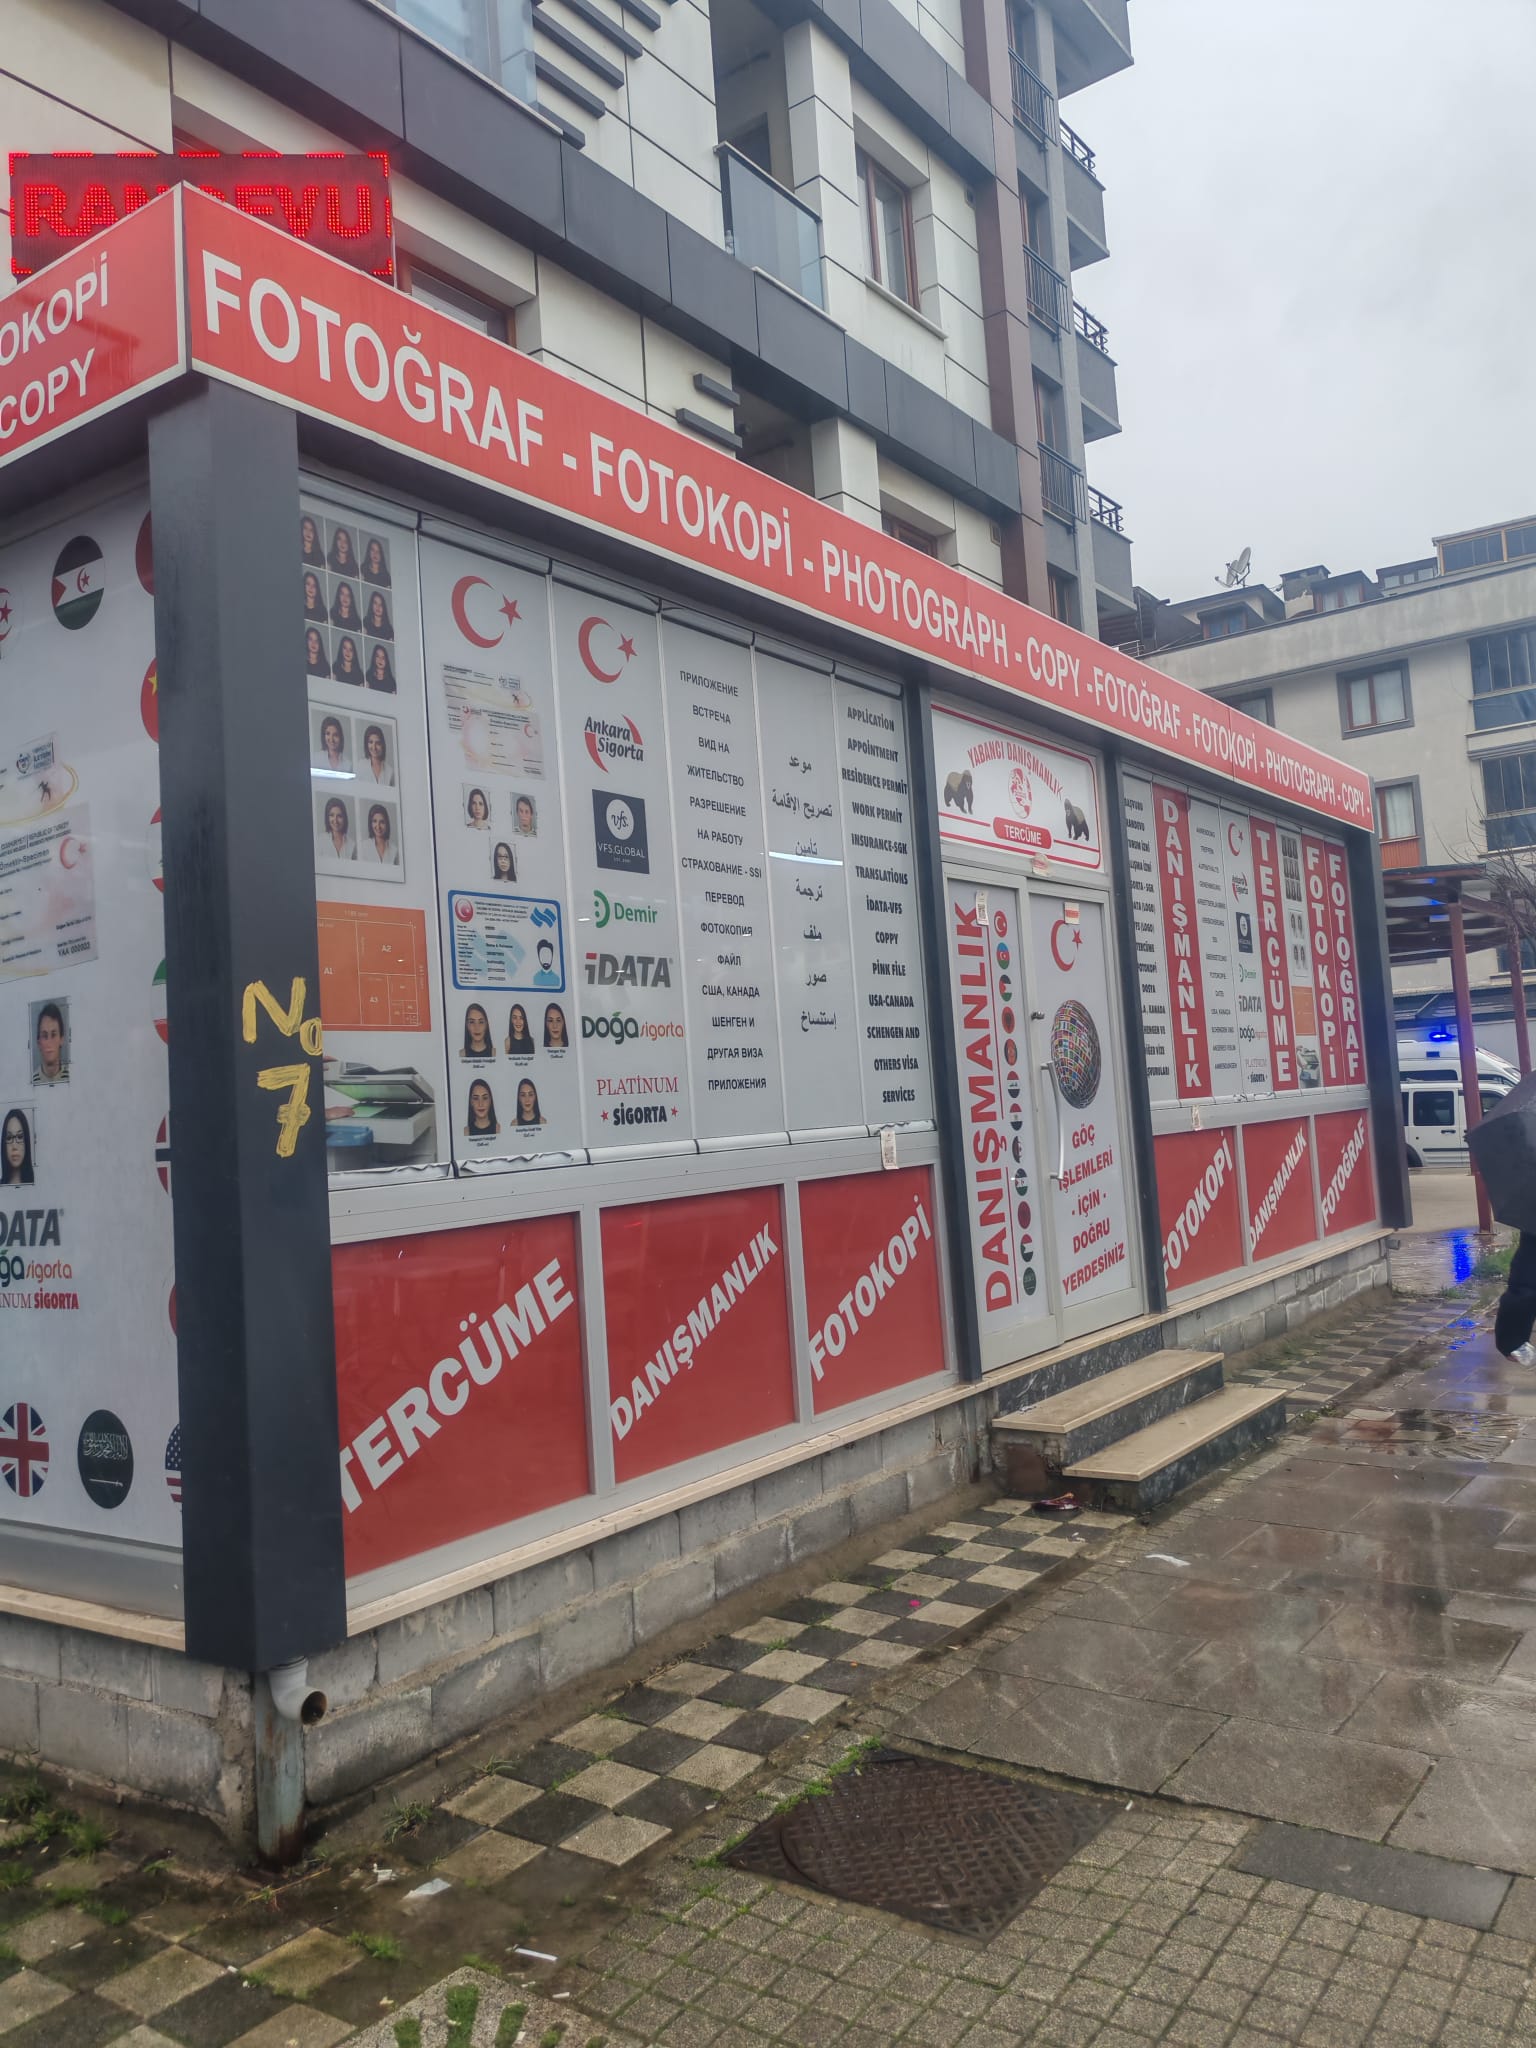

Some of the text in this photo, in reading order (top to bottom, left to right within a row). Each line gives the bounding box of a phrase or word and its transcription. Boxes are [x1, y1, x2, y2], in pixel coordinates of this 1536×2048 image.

[0, 251, 107, 366] OKOPİ
[0, 348, 95, 438] COPY
[202, 250, 544, 467] FOTOĞRAF
[590, 432, 793, 576] FOTOKOPİ
[821, 540, 1008, 668] PHOTOGRAPH
[1026, 637, 1080, 697] COPY
[1193, 713, 1258, 773] FOTOKOPİ
[1266, 748, 1336, 806] PHOTOGRAPH
[1341, 783, 1364, 816] COPY
[679, 670, 739, 697] ПРИЛОЖЕНИЕ
[692, 704, 731, 724] ВСТРЕЧА
[584, 716, 631, 742] Ankara
[597, 737, 644, 762] Sigorta
[698, 737, 730, 754] ВИД НА
[687, 764, 744, 787] ЖИТЕЛЬСТВО
[968, 740, 1064, 801] YABANCI DANIŞMANLIK
[689, 796, 747, 817] РАЗРЕШЕНИЕ
[852, 801, 876, 818] WORK
[697, 828, 744, 846] НА РАБОТУ
[1004, 824, 1042, 846] TERCÜME
[681, 857, 743, 876] СТРАХОВАНИЕ
[705, 891, 745, 907] ПЕРЕВОД
[614, 902, 658, 923] Demir
[700, 922, 753, 937] ФОТОКОПИЯ
[875, 931, 899, 944] COPPY
[1162, 799, 1202, 1088] DANIŞMANLIK
[717, 953, 742, 966] ФАЙЛ
[1256, 829, 1291, 1082] TERCÜME
[1306, 847, 1336, 1078] FOTOKOPİ
[1328, 853, 1359, 1078] FOTOĞRAF
[726, 986, 760, 999] КАНАДА
[868, 993, 914, 1008] USA-CANADA
[712, 1016, 755, 1028] ШЕНГЕН И
[867, 1026, 920, 1039] SCHENGEN AND
[707, 1047, 763, 1060] ДРУГАЯ ВИЗА
[874, 1058, 901, 1071] OTHERS
[597, 1075, 679, 1096] PLATİNUM
[708, 1078, 766, 1091] ПРИЛОЖЕНИЯ
[256, 1062, 311, 1158] 7
[613, 1103, 667, 1126] SİGORTA
[955, 902, 1013, 1312] DANIŞMANLIK
[1072, 1124, 1095, 1149] GÖÇ
[1321, 1117, 1365, 1228] FOTOĞRAF
[1250, 1127, 1308, 1251] DANIŞMANLIK
[1078, 1189, 1101, 1218] İÇİN
[1073, 1218, 1110, 1254] DOĞRU
[1062, 1242, 1126, 1296] YERDESİNİZ
[34, 1287, 79, 1310] SİGORTA
[808, 1194, 932, 1382] FOTOKOPİ
[609, 1222, 779, 1441] DANIŞMANLIK
